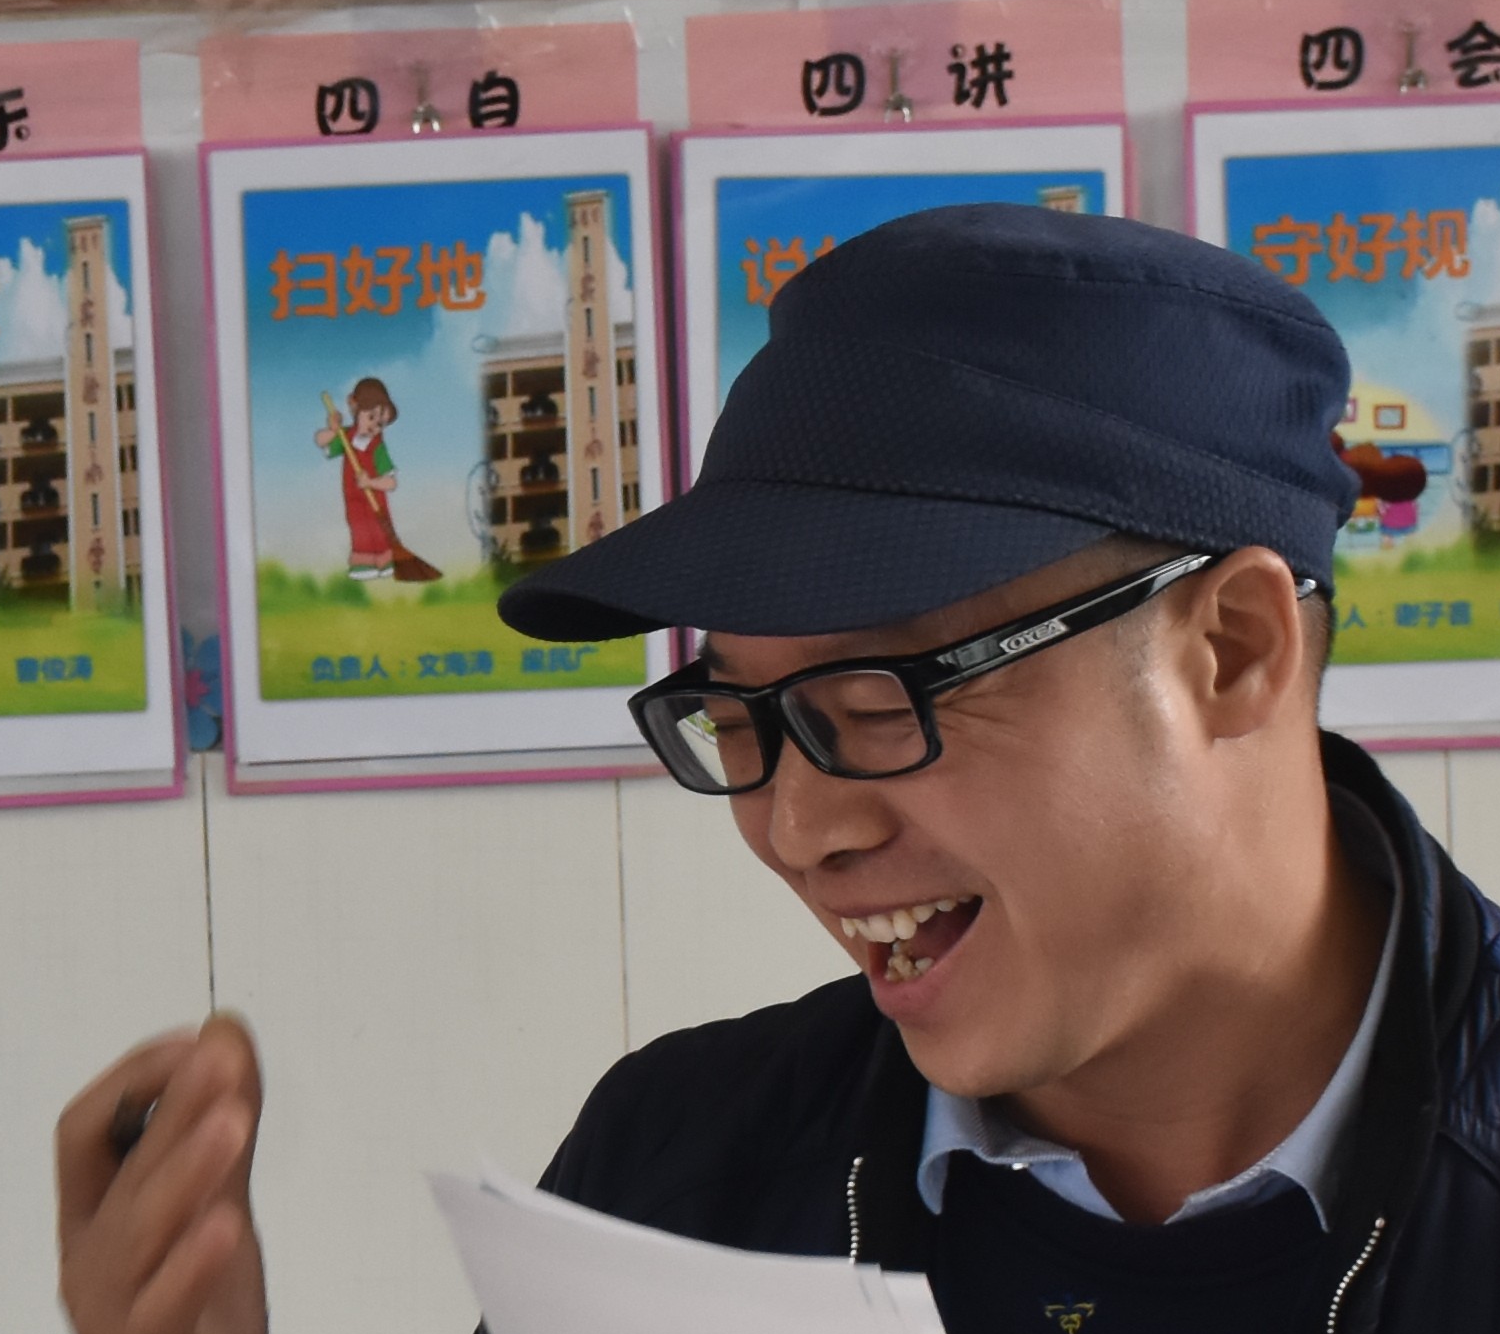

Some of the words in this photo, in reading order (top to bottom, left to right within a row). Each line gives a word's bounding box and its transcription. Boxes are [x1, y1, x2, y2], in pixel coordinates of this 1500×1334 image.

[316, 72, 520, 136] 四自
[802, 42, 1014, 116] 四讲
[269, 241, 487, 321] 扫好地
[1252, 208, 1472, 286] 守好规
